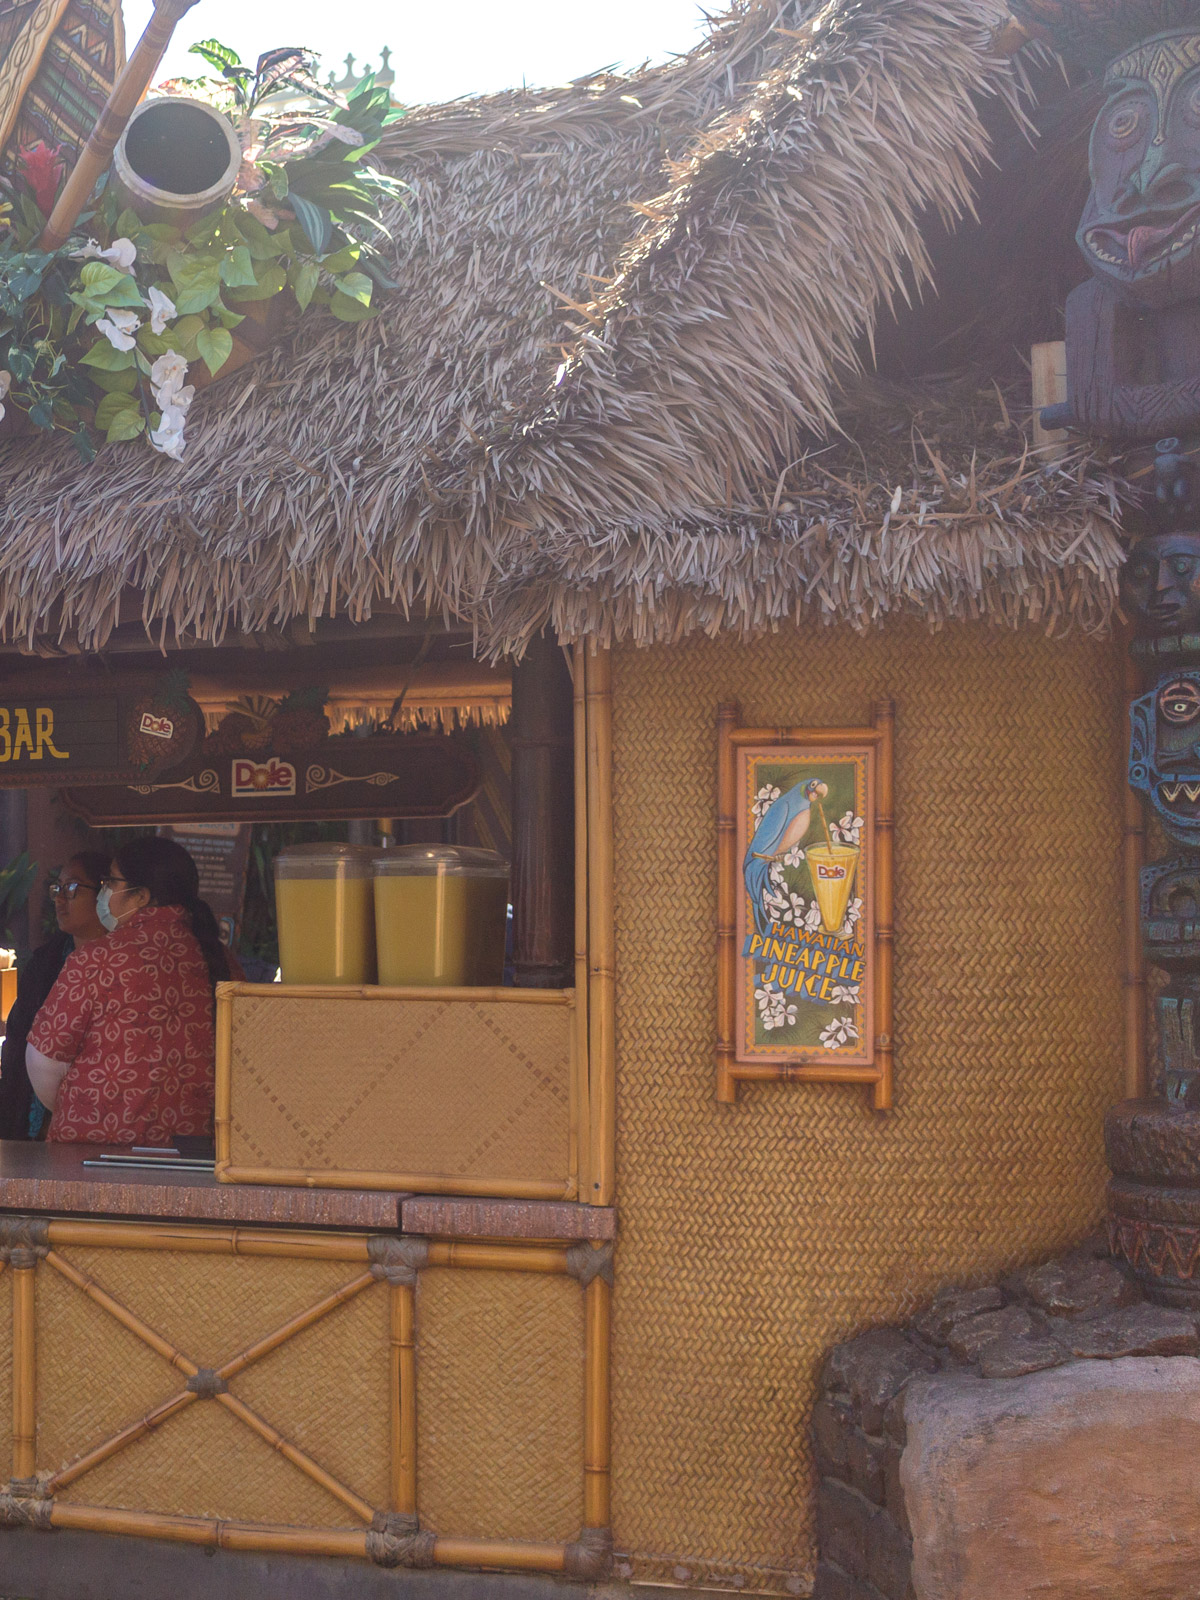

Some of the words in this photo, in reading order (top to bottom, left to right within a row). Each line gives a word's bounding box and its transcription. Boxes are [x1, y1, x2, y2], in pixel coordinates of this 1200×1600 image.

[141, 715, 172, 735] Dole
[235, 760, 293, 789] Dole
[818, 866, 845, 877] Dole
[771, 922, 865, 957] HAWAIIAN
[749, 933, 866, 982] PINEAPPLE
[761, 963, 837, 1001] JUICE
